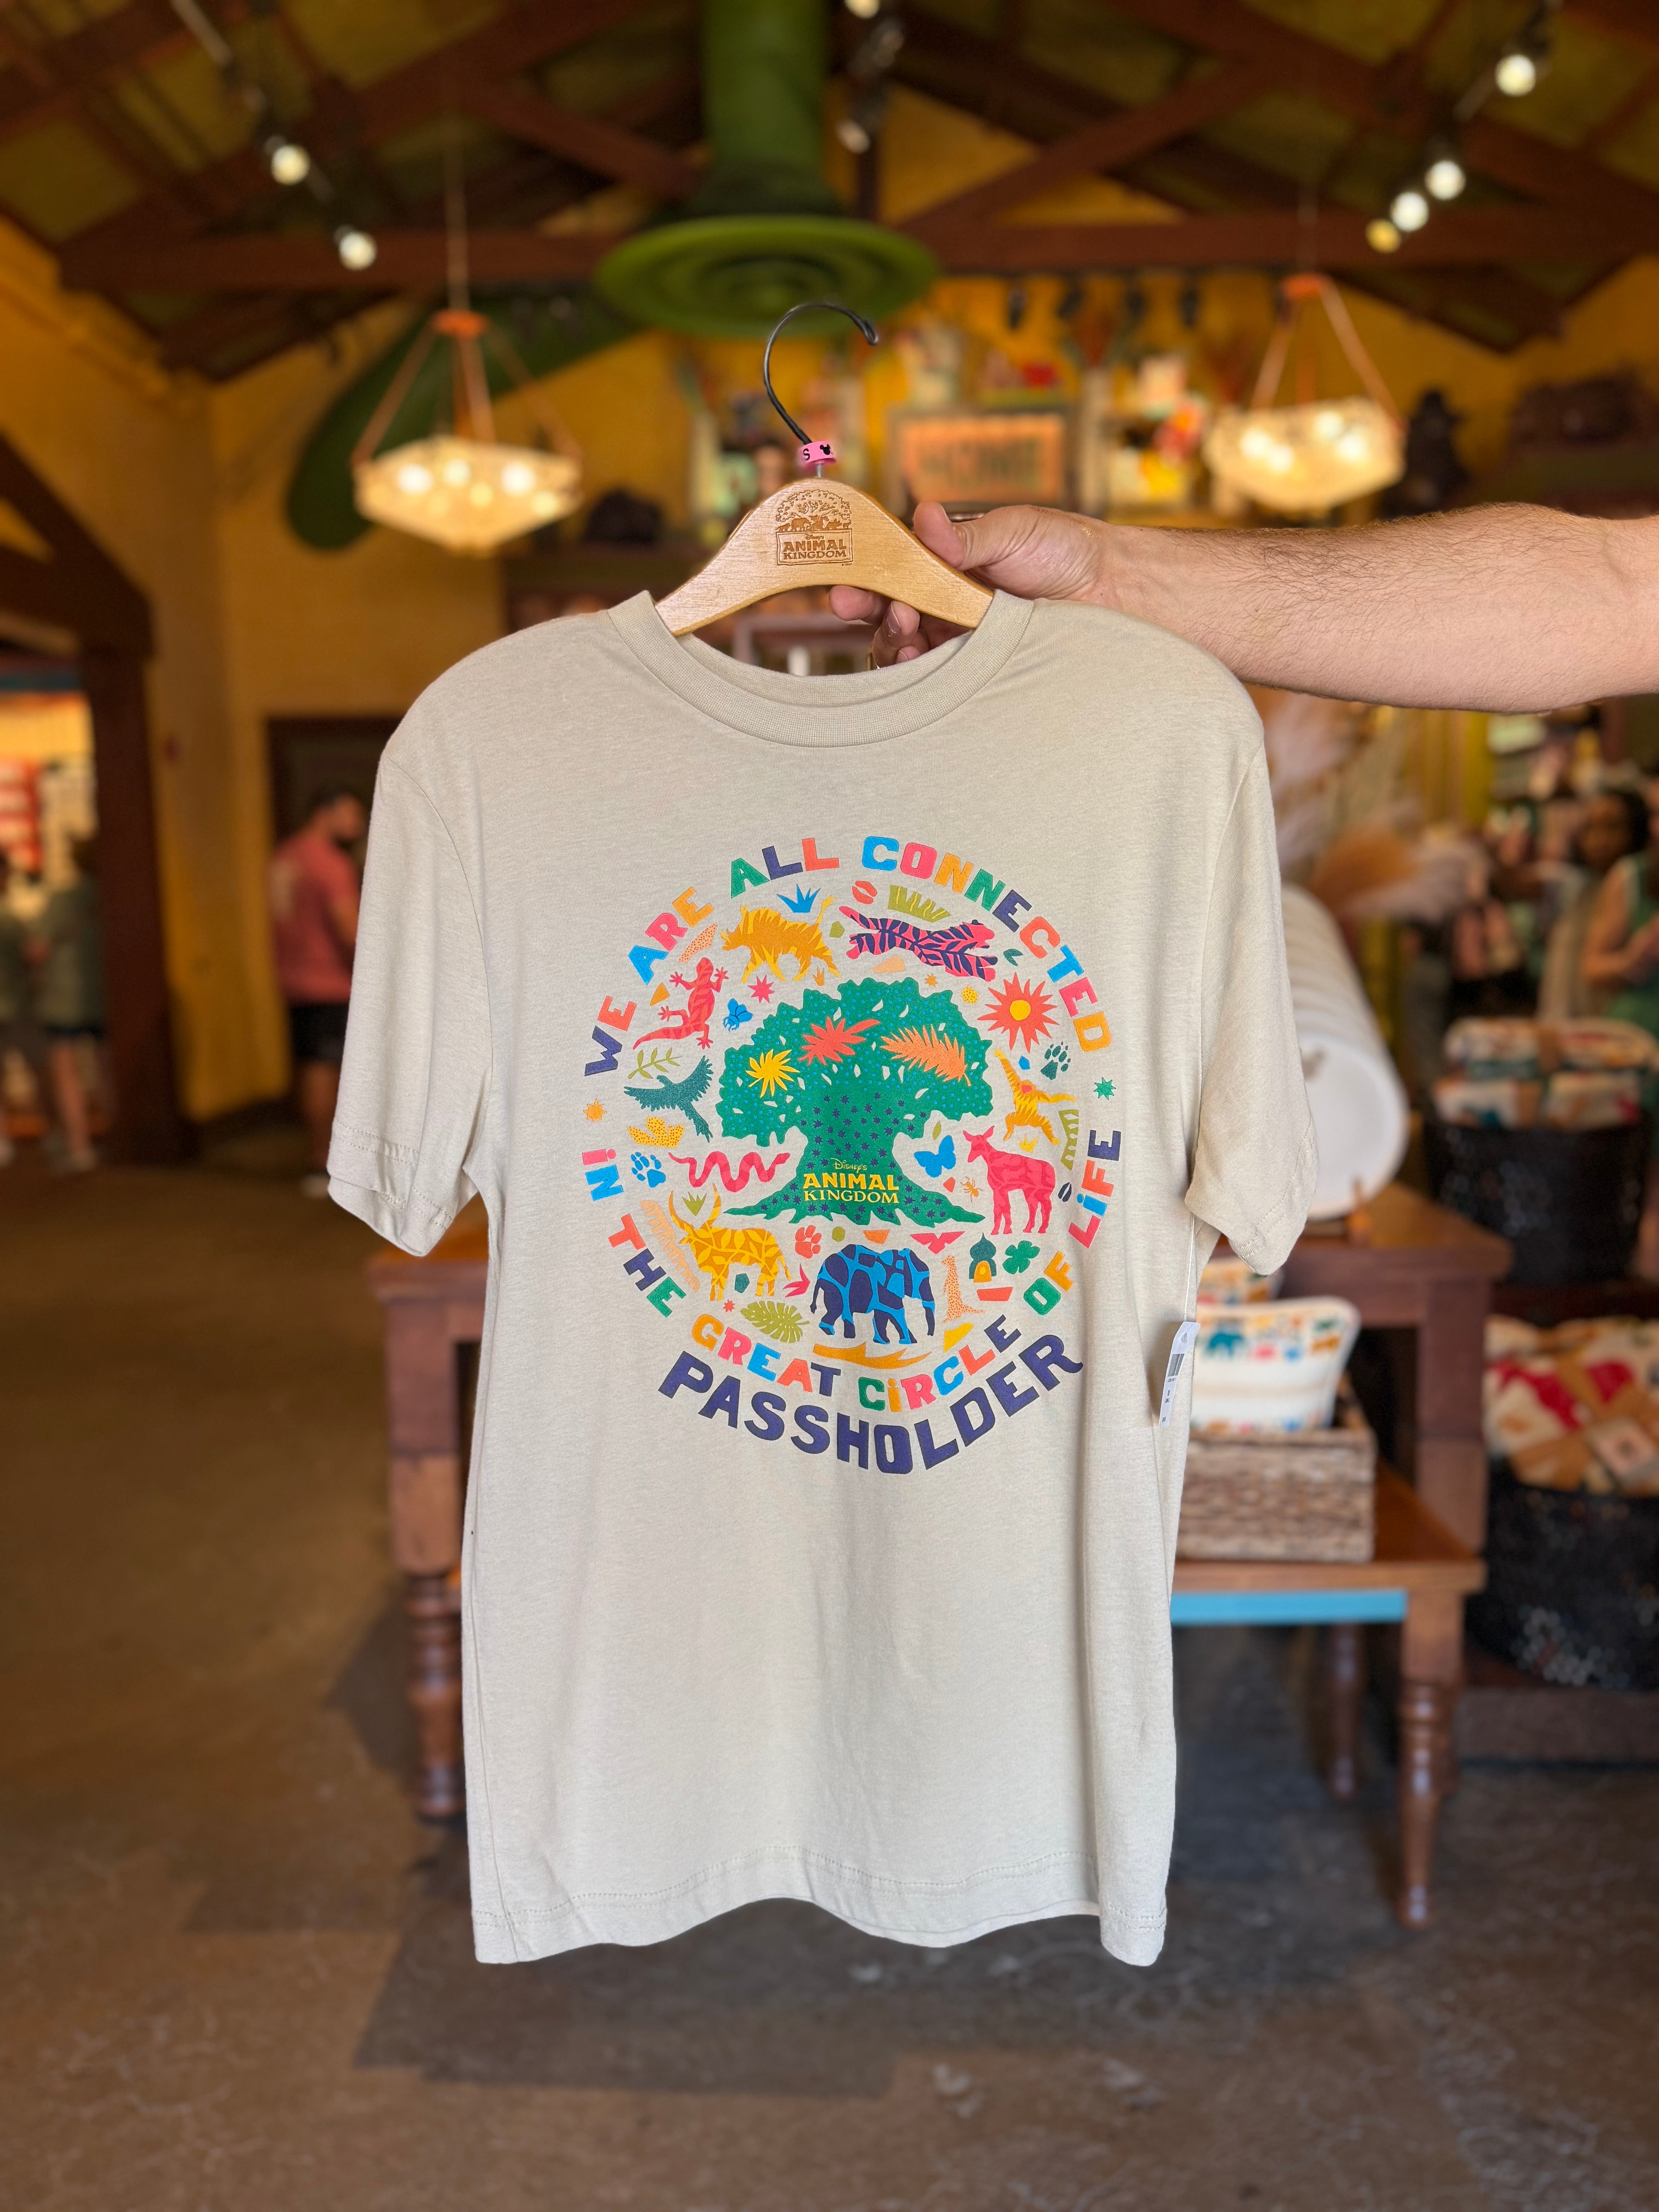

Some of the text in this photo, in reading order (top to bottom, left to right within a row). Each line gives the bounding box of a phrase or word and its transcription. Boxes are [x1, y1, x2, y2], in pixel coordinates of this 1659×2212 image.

[803, 448, 810, 461] S
[783, 539, 847, 552] ANIMAL
[783, 550, 847, 560] KINGDOM
[584, 836, 1112, 1076] WE ARE ALL CONNECTED
[830, 1158, 867, 1174] Disney's
[803, 1172, 900, 1190] ANIMAL
[803, 1190, 900, 1204] KINGDOM
[608, 1213, 687, 1318] THE
[691, 1314, 841, 1397] GREAT
[1023, 1251, 1075, 1316] OF
[658, 1334, 1084, 1475] PASSHOLDER
